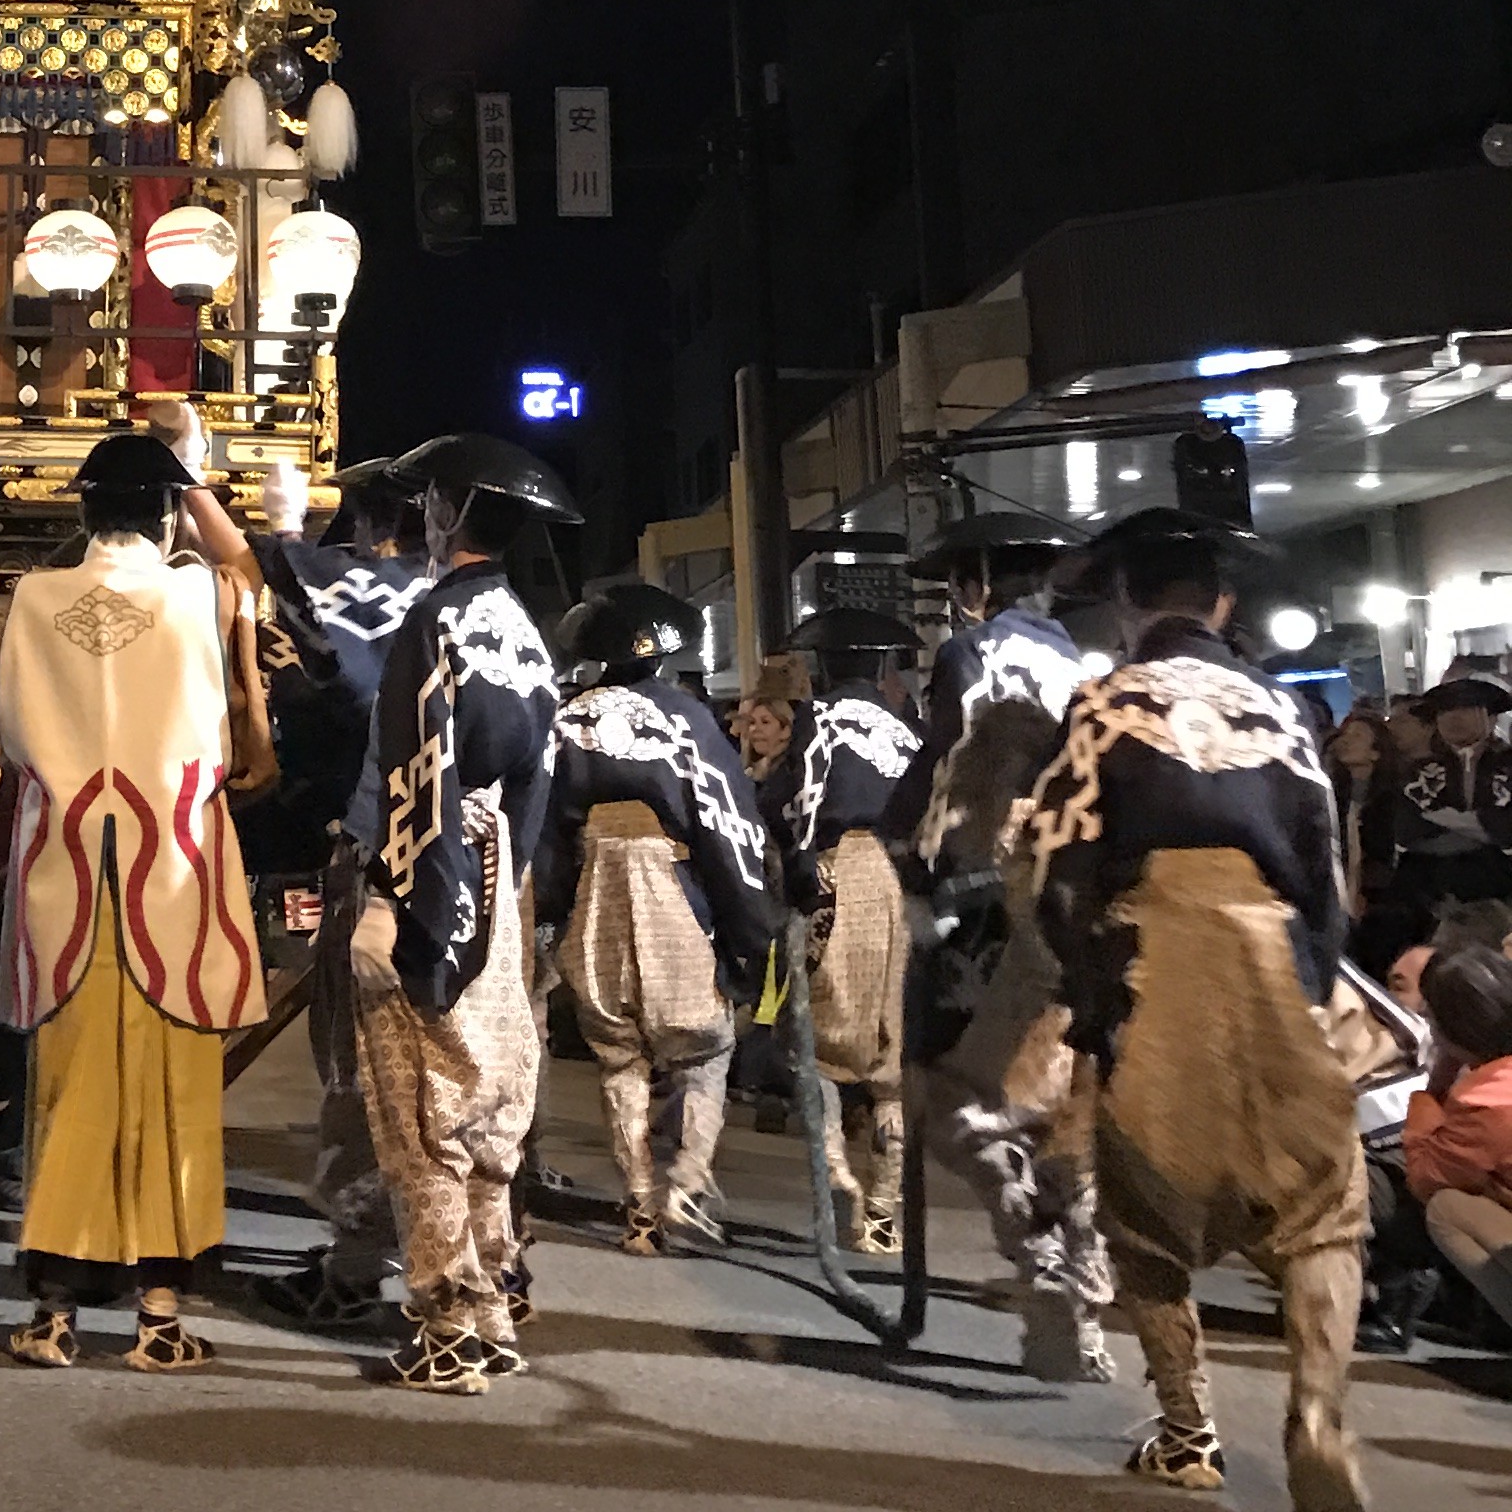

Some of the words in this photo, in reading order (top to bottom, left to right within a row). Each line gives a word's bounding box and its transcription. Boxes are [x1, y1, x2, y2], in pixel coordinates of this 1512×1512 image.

[483, 102, 510, 216] 歩車分離式
